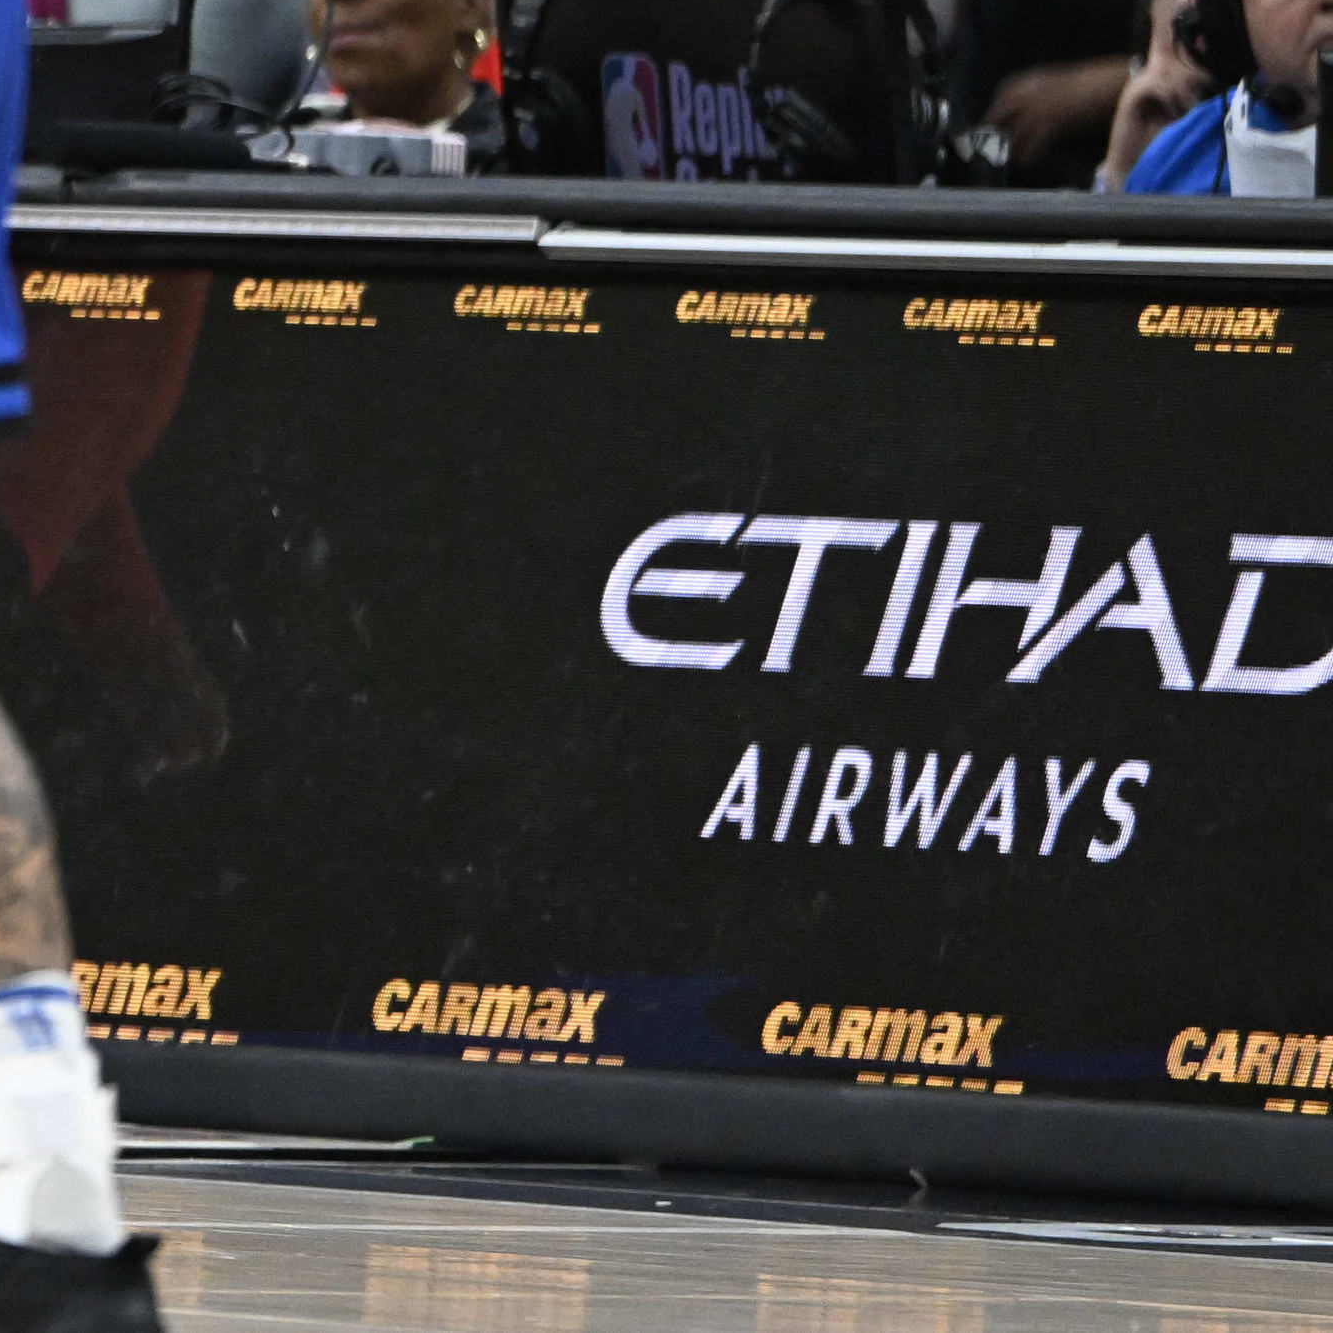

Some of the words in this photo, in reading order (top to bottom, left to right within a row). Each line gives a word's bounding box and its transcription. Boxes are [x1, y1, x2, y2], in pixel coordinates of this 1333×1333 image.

[668, 59, 783, 175] Repl
[599, 511, 1333, 695] ETIHAD
[699, 741, 1151, 863] AIRWAYS
